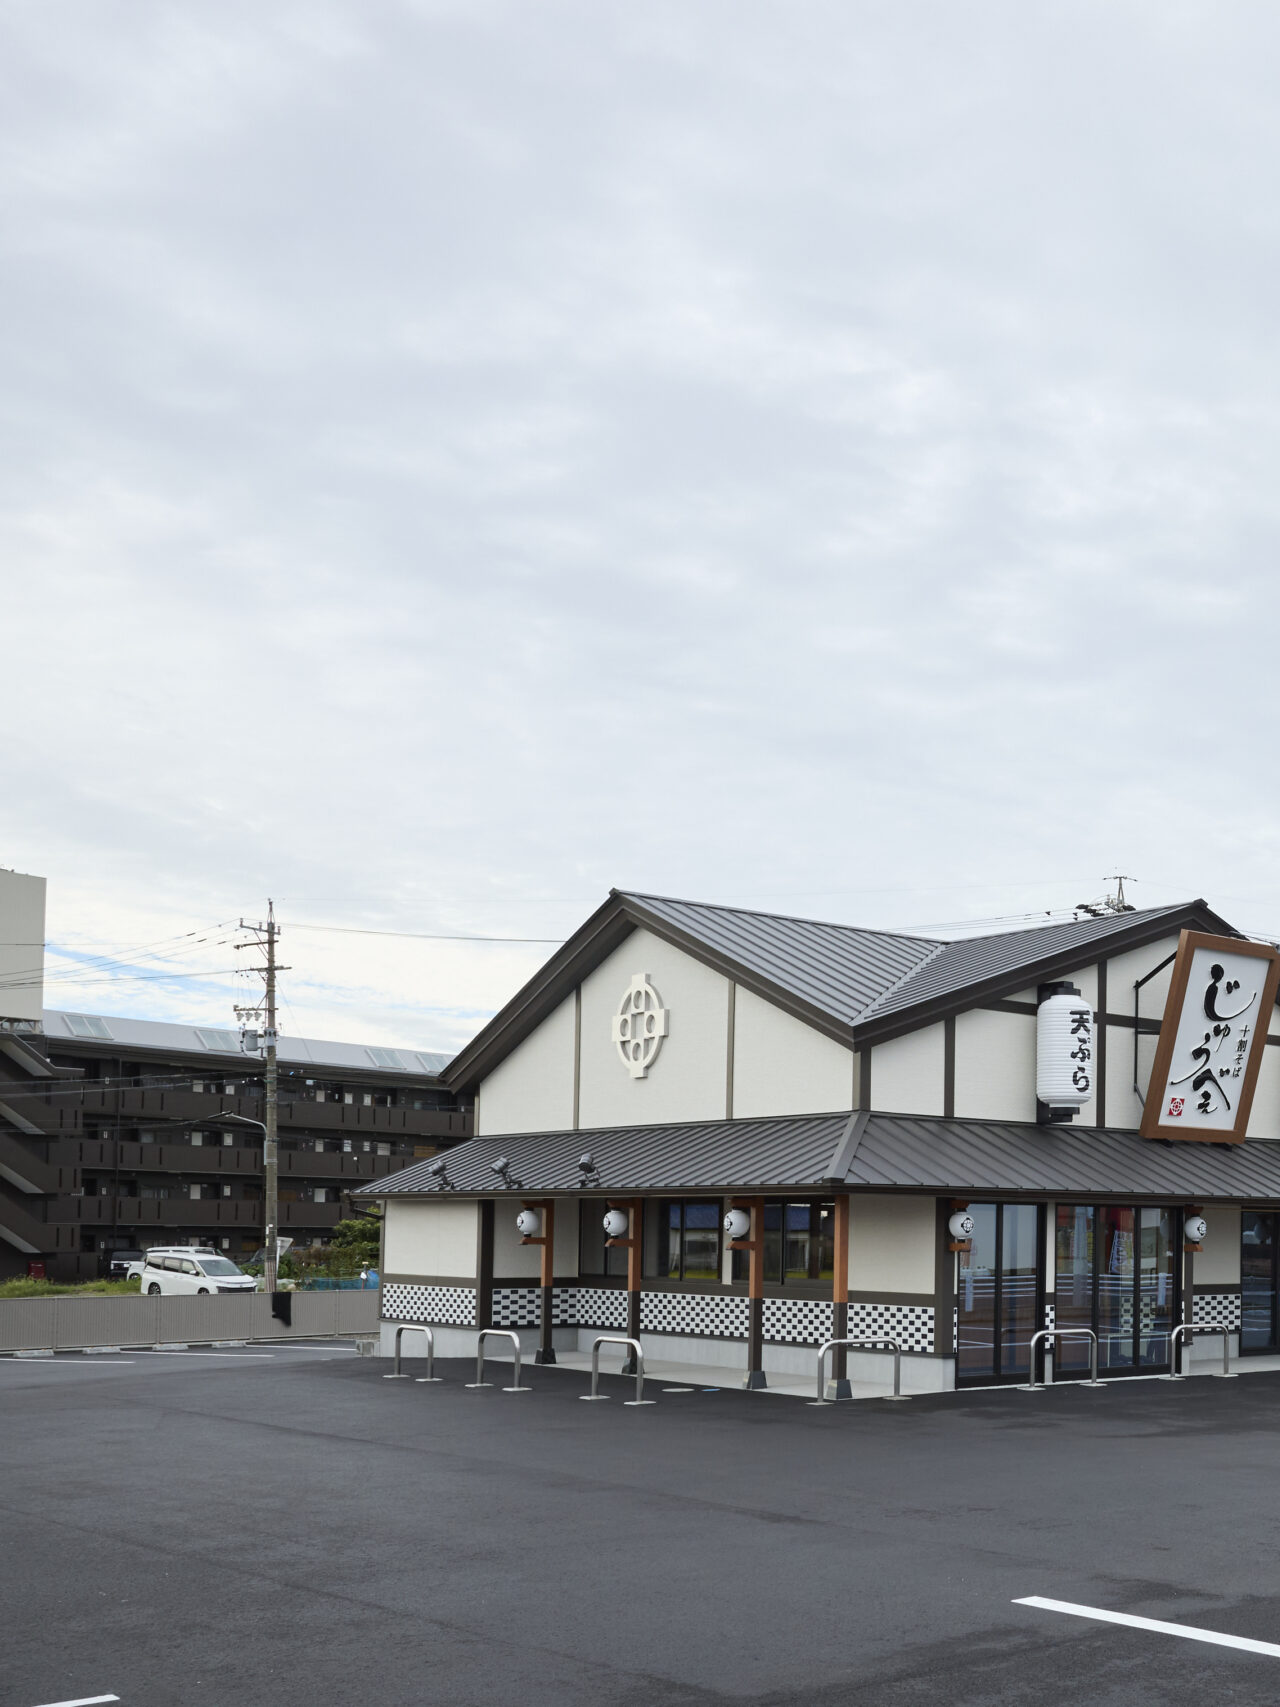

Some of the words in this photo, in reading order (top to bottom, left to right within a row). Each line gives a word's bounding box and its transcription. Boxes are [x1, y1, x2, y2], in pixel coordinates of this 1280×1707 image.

[1069, 1009, 1092, 1093] 天ぷら
[1231, 1024, 1251, 1079] 十割そば
